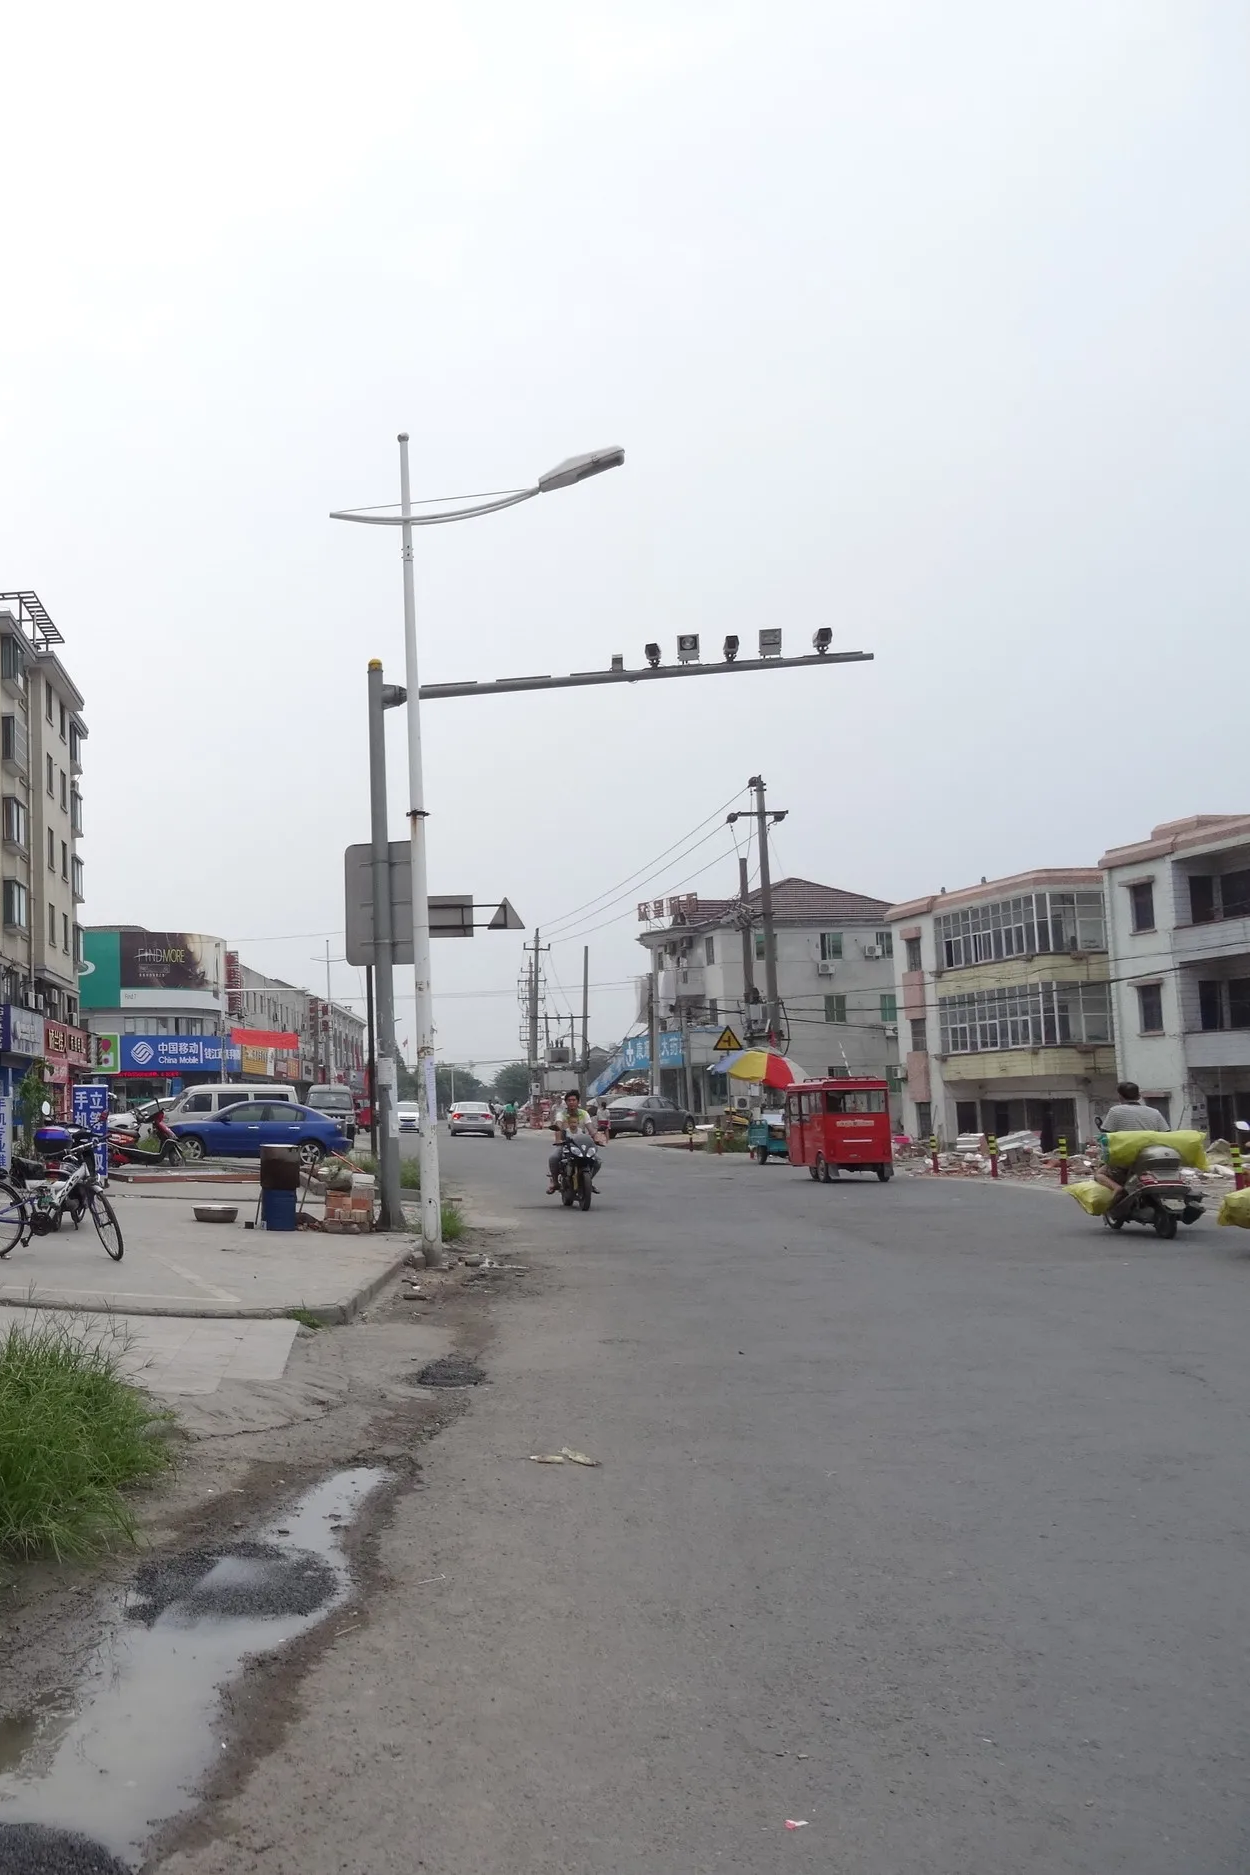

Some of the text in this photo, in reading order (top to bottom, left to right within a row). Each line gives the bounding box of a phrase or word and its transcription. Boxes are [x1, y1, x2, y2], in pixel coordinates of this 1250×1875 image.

[158, 1042, 198, 1054] 中国移动
[158, 1056, 198, 1064] China Mobile
